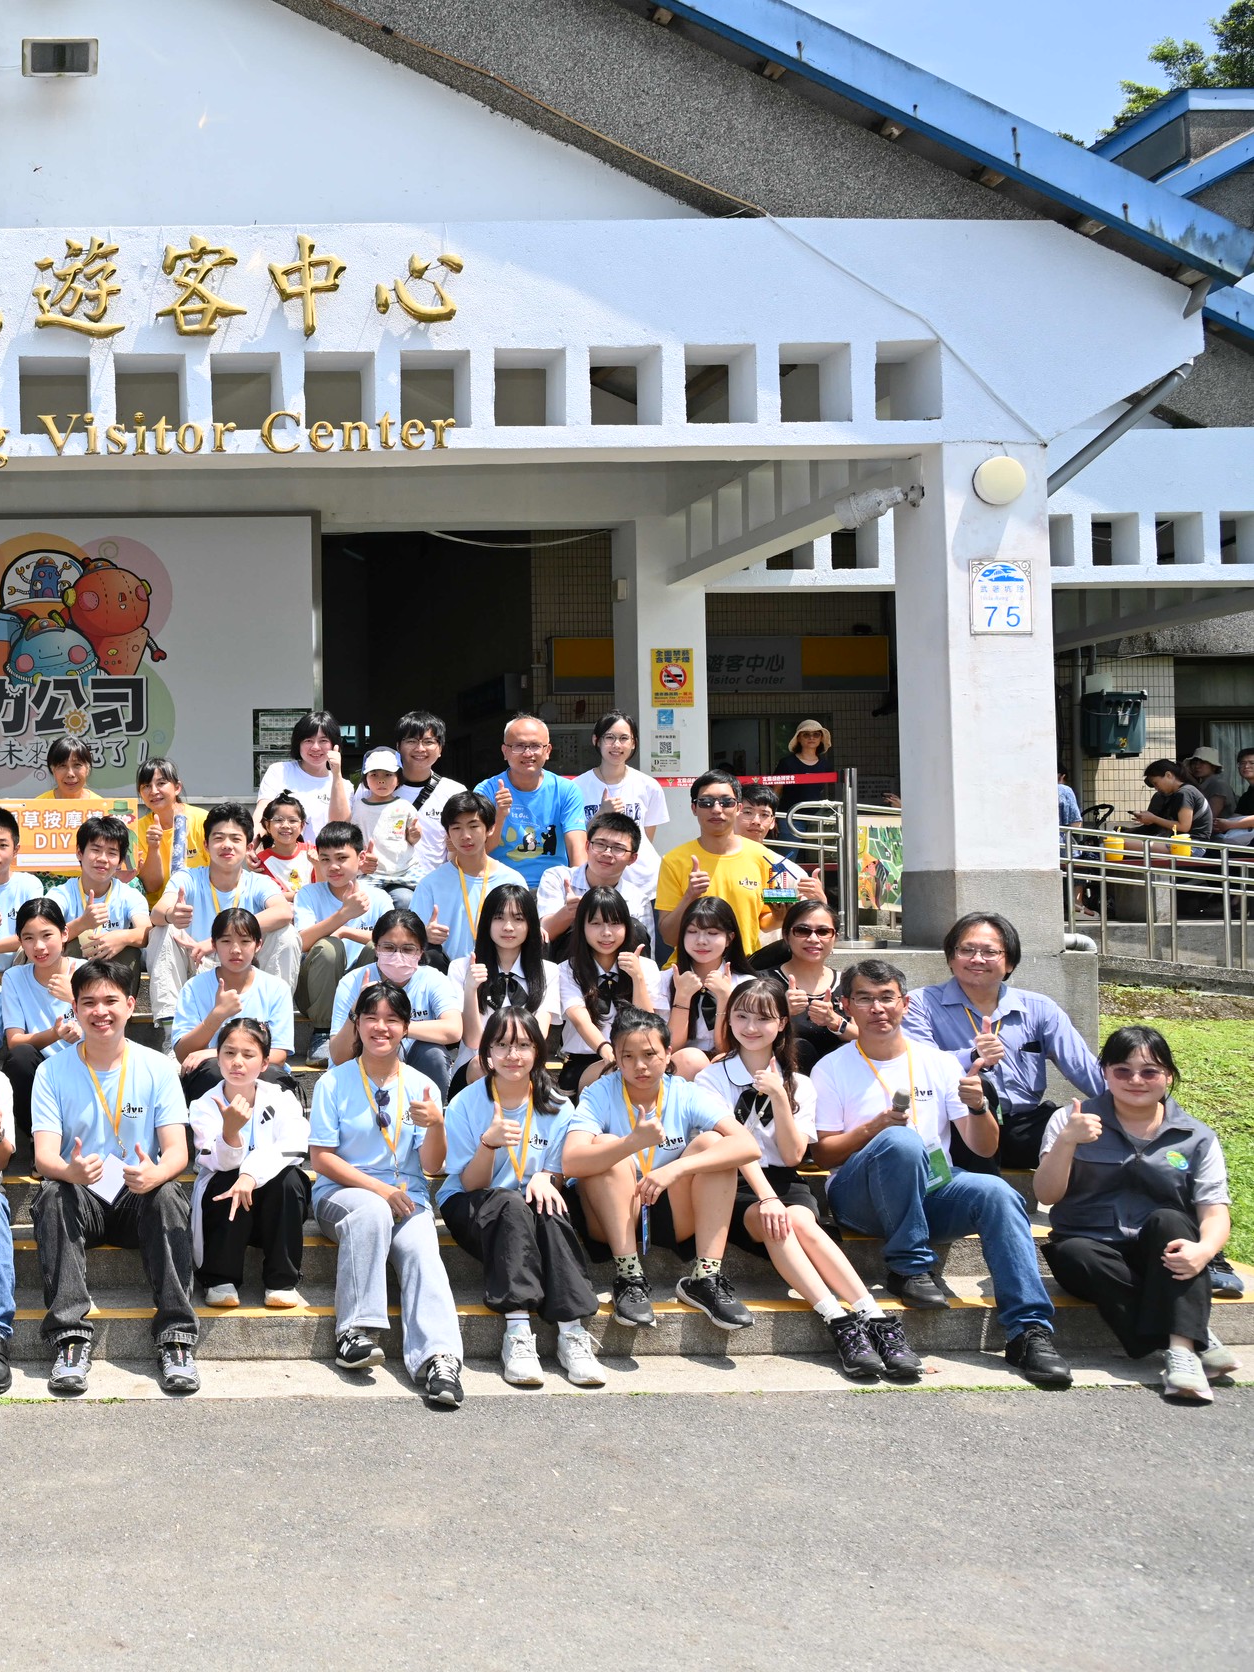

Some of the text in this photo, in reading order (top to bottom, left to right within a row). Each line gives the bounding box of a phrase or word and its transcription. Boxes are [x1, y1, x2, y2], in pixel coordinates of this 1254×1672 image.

[36, 412, 237, 456] Visitor
[261, 411, 457, 453] Center
[984, 606, 1021, 627] 75
[707, 654, 785, 673] 遊客中心
[746, 674, 786, 685] Center
[35, 833, 72, 849] DIY
